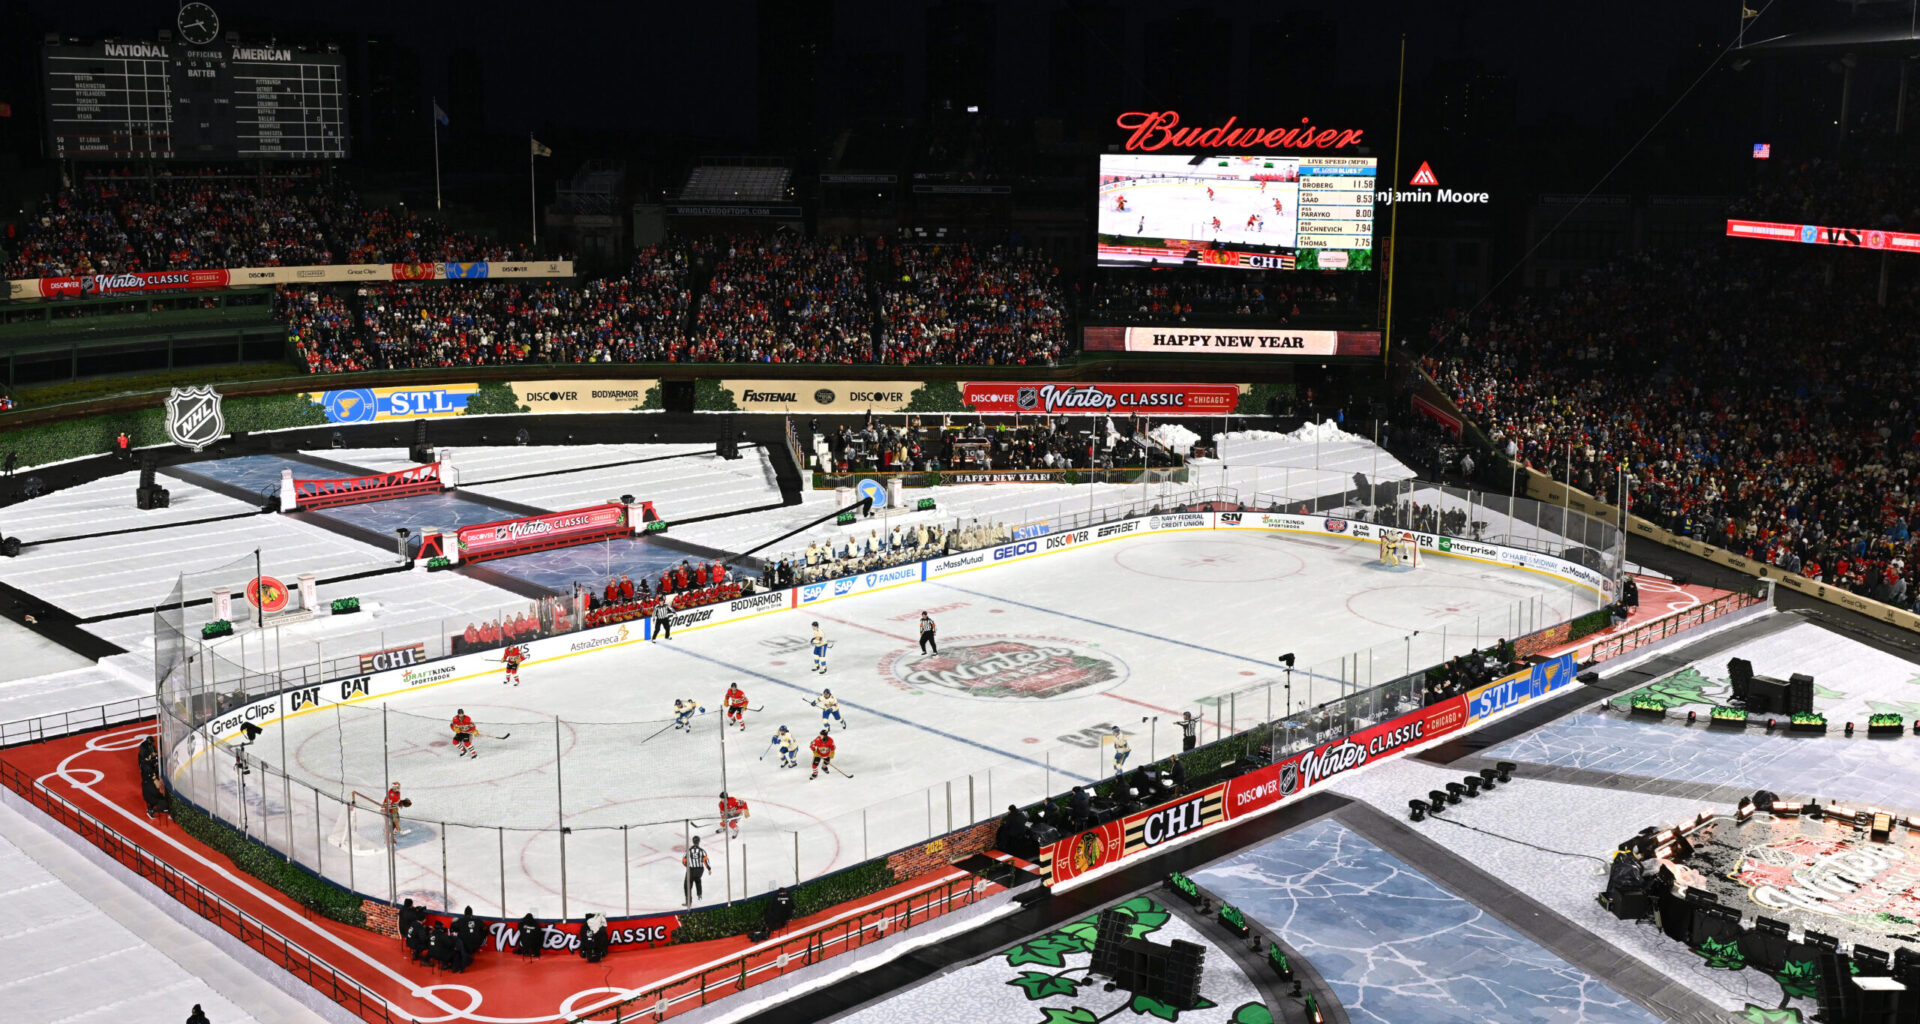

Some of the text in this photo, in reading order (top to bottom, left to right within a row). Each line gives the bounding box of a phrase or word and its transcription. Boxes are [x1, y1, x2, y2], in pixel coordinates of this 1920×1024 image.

[105, 44, 169, 58] NATIONAL
[187, 51, 222, 60] OFFICIALS
[232, 48, 291, 61] AMERICAN
[187, 69, 216, 78] BATTER
[1116, 110, 1364, 151] Budweiser
[1347, 158, 1369, 166] (MPH)
[1353, 180, 1374, 189] 11.58
[1356, 194, 1373, 202] 8.53
[1375, 189, 1490, 207] njamin Moore
[677, 206, 771, 216] WRIGLEYROOFTOPS.COM
[1355, 209, 1372, 218] 8.00
[1355, 223, 1371, 232] 7.94
[1354, 238, 1371, 247] 7.75
[1826, 227, 1863, 247] VS
[1249, 255, 1284, 269] CHI
[51, 281, 80, 290] DISCOVER
[95, 274, 146, 292] Winter
[147, 274, 190, 285] CLASSIC
[1153, 334, 1304, 349] HAPPY NEW YEAR
[526, 391, 579, 402] DISCOVER
[592, 390, 639, 399] BODYARMOR
[742, 389, 798, 403] FASTENAL
[849, 391, 904, 402] DISCOVER
[971, 384, 1222, 412] DISCOVER Winter CLASSIC CHICAGO
[390, 391, 452, 415] STL
[181, 402, 214, 435] NHL
[956, 473, 1050, 483] HAPPY NEW YEAR!
[1220, 512, 1243, 522] SN
[468, 532, 494, 542] DISCOVER
[508, 520, 553, 541] Winter
[554, 515, 590, 529] CLASSIC
[1161, 521, 1182, 529] CREDIT
[1046, 531, 1089, 550] DISCOVER
[1442, 538, 1497, 557] enterprise
[994, 541, 1038, 560] GEICO
[1501, 552, 1527, 563] O'HARE
[943, 553, 984, 570] MassMutual
[1728, 556, 1746, 568] verizon
[879, 568, 915, 583] FANDUEL
[804, 585, 823, 600] SAP
[835, 580, 853, 595] SAP
[730, 592, 782, 612] BODYARMOR
[1841, 596, 1854, 606] Great
[570, 635, 619, 651] AstraZeneca
[372, 647, 418, 671] CHI
[403, 666, 456, 682] DRAFTKINGS
[906, 646, 1075, 689] Winter
[411, 674, 450, 686] SPORTSBOOK
[341, 677, 371, 700] CAT
[291, 687, 320, 712] CAT
[1479, 679, 1519, 718] STL
[211, 713, 244, 736] Great
[244, 702, 275, 720] Clips
[1237, 779, 1278, 807] DISCOVER
[1299, 738, 1368, 790] Winter
[1369, 720, 1424, 756] CLASSIC
[1430, 710, 1458, 729] CHICAGO
[1144, 797, 1204, 846] CHI
[926, 838, 943, 855] 2025
[490, 922, 666, 953] Wter ASSIC
